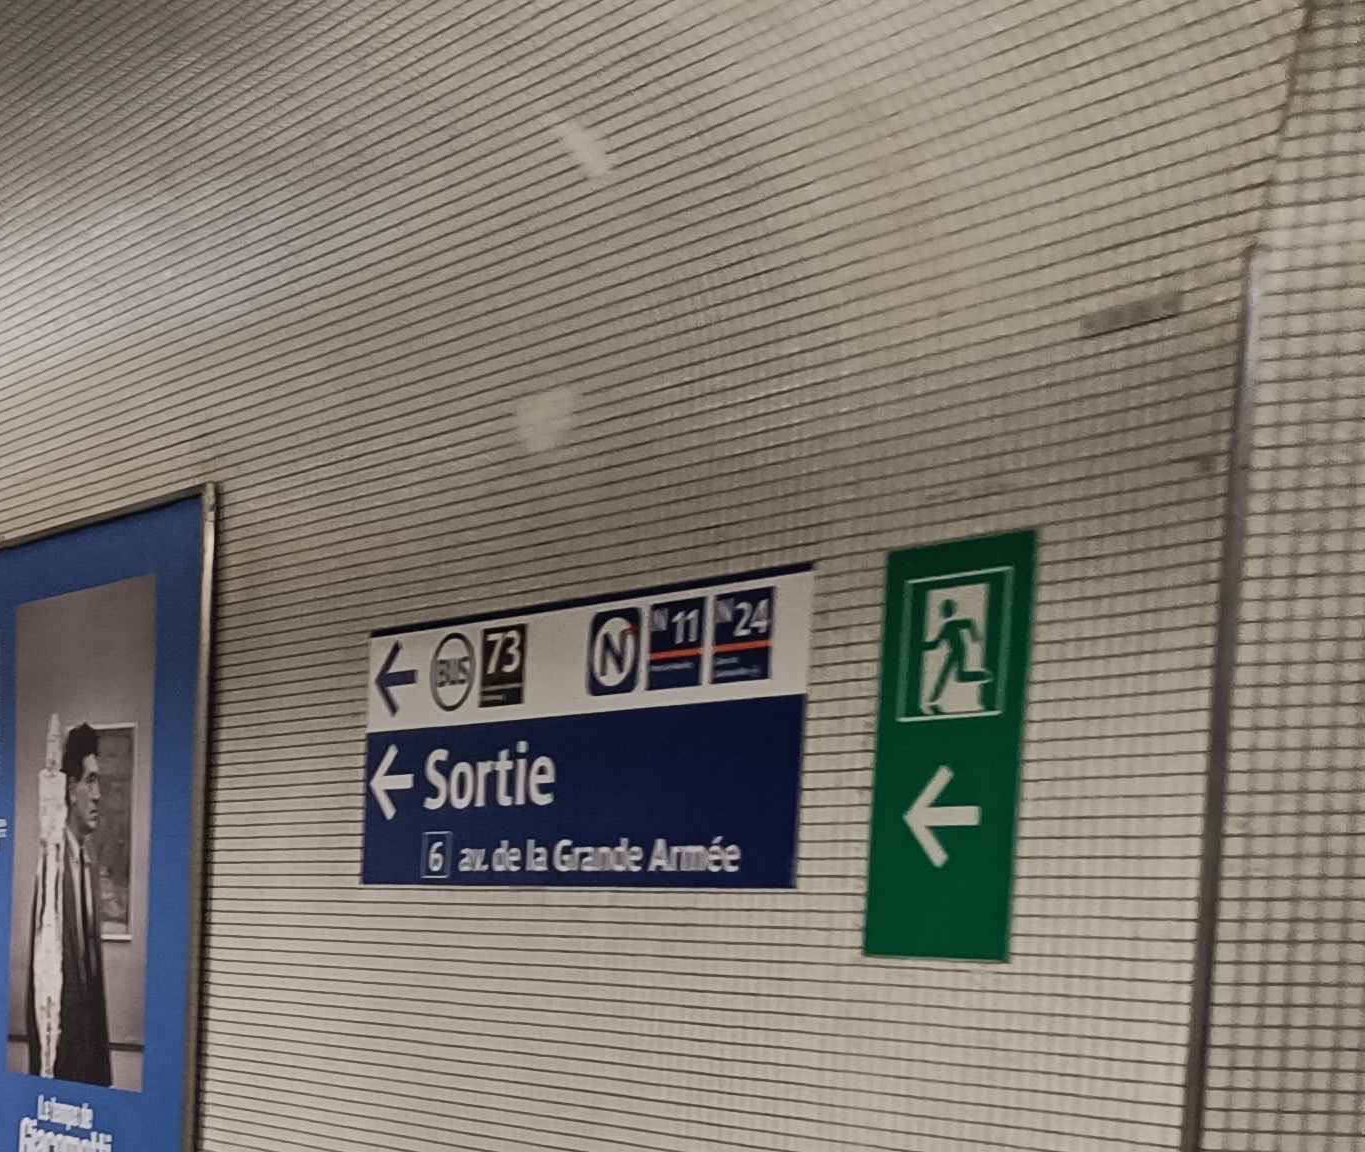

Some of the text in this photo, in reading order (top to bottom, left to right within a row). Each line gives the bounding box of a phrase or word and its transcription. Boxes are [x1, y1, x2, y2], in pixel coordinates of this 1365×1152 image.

[435, 629, 522, 688] BUS 73
[422, 740, 557, 811] Sortie
[427, 835, 741, 873] 6 av. de la Grande Armée
